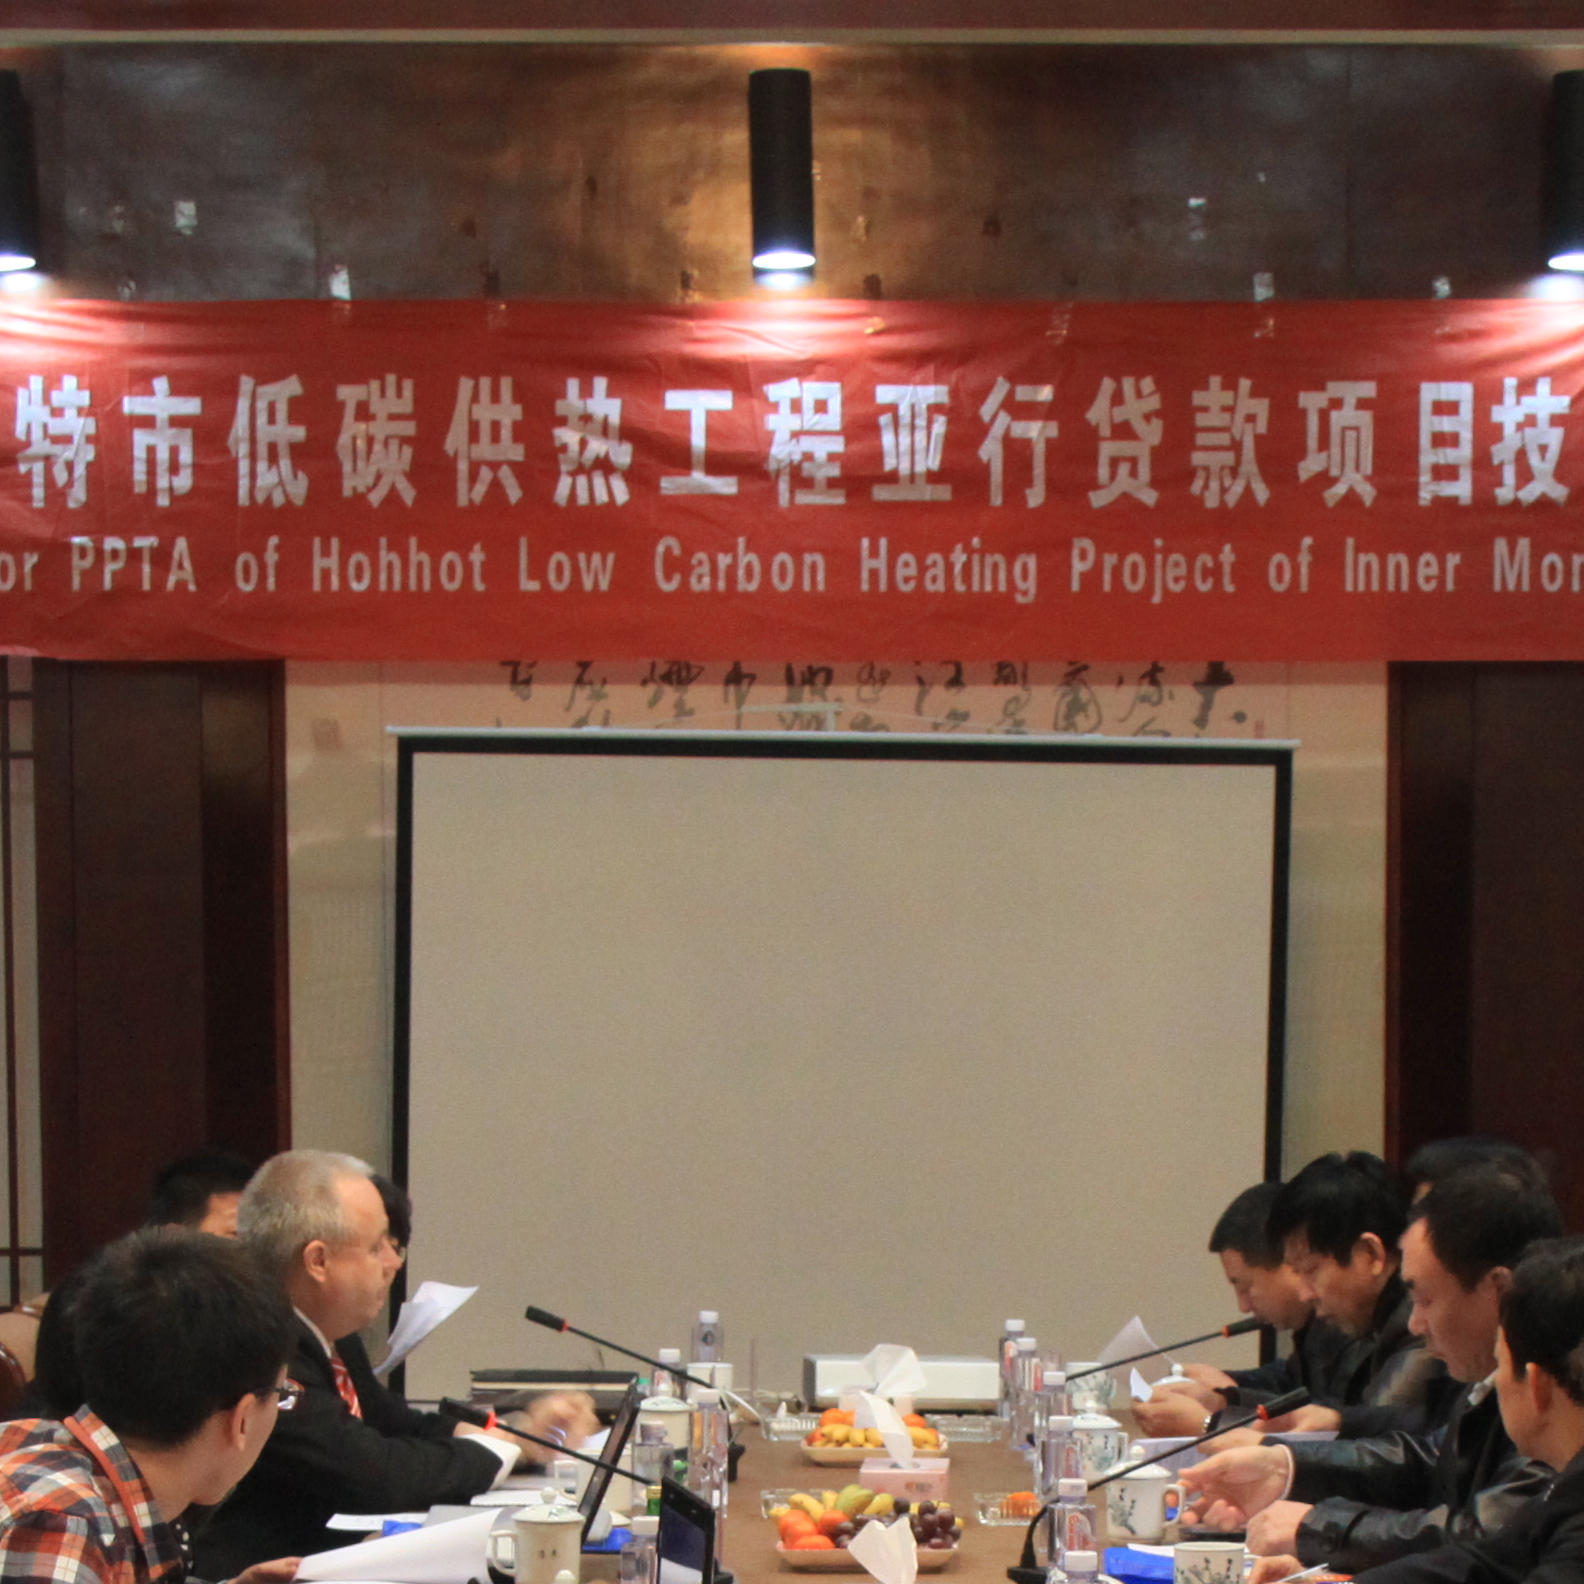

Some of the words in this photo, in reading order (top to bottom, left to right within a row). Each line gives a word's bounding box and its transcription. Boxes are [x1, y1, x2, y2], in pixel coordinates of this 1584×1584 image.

[68, 533, 198, 593] PPTA
[234, 534, 281, 594] of
[311, 535, 487, 593] Hohhot
[518, 536, 616, 593] Low
[653, 535, 827, 594] Carbon
[859, 536, 1038, 605] Heating
[1070, 537, 1236, 605] Project
[1267, 535, 1314, 593] of
[1344, 536, 1463, 593] Inner
